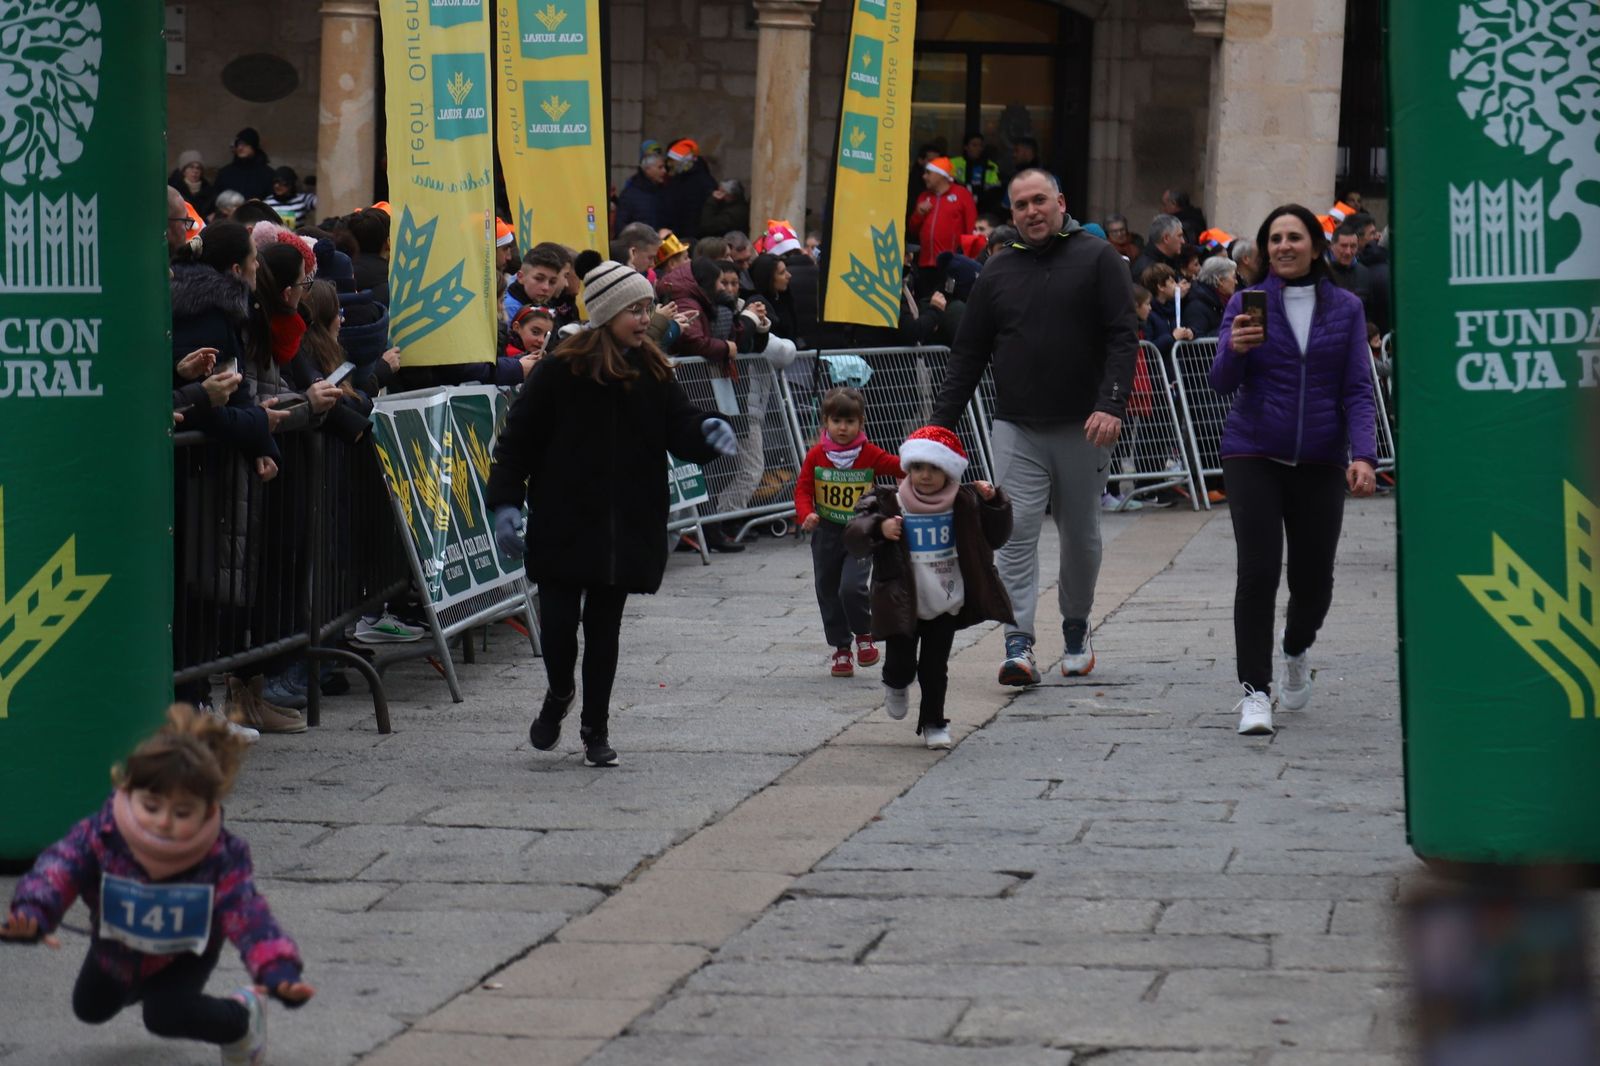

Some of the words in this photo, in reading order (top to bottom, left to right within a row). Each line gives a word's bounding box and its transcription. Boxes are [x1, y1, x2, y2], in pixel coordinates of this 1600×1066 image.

[881, 57, 898, 128] Ourense
[879, 142, 894, 182] León
[1456, 351, 1567, 394] CAJA
[821, 484, 865, 508] 1887
[913, 526, 949, 546] 118
[121, 900, 184, 932] 141
